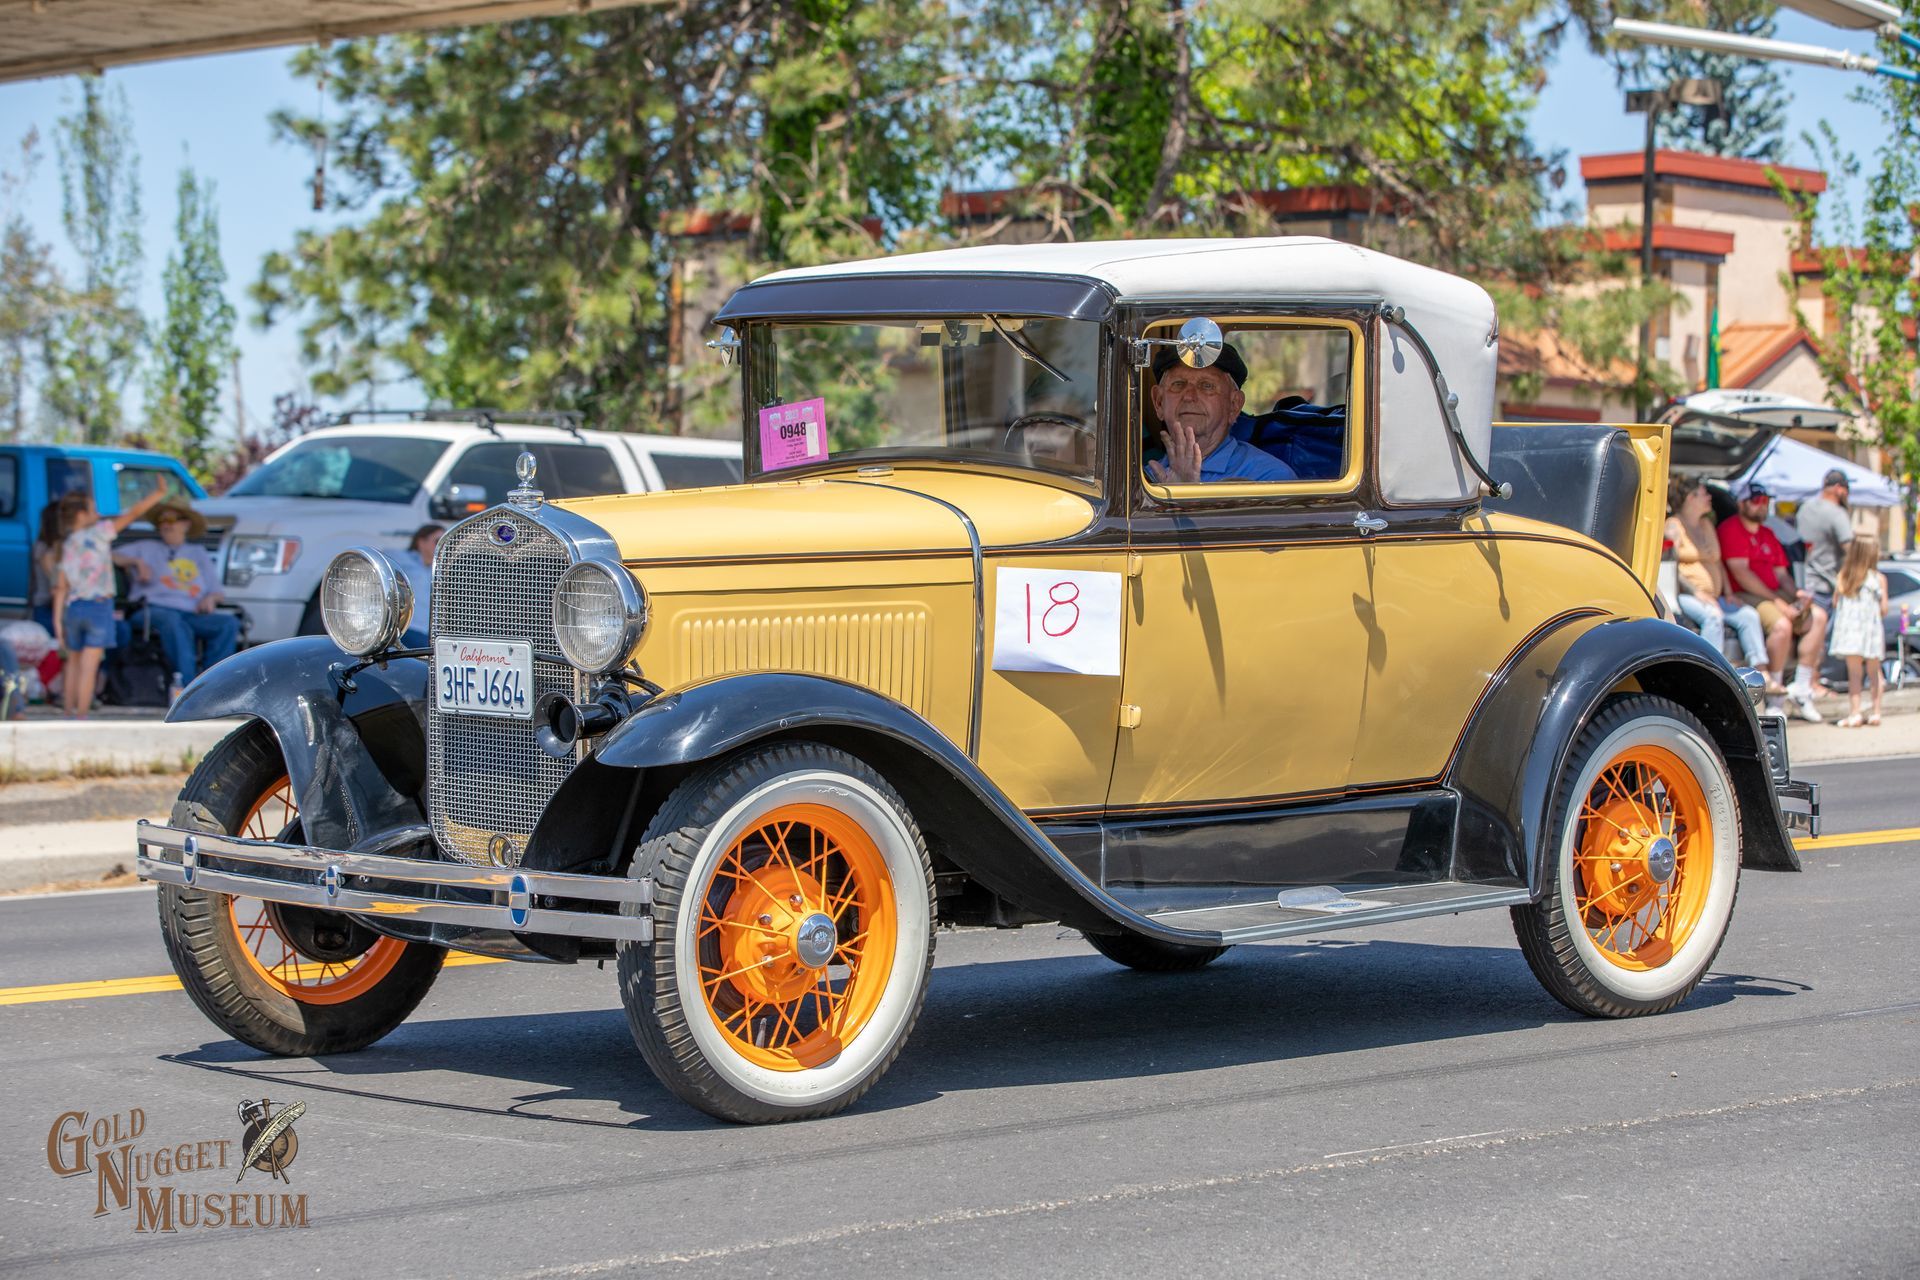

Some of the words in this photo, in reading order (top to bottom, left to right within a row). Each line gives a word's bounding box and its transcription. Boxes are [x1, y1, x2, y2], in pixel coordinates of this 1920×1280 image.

[780, 421, 807, 440] 0948
[1026, 581, 1080, 644] 18
[460, 646, 511, 665] California
[443, 666, 525, 707] 3HFJ664
